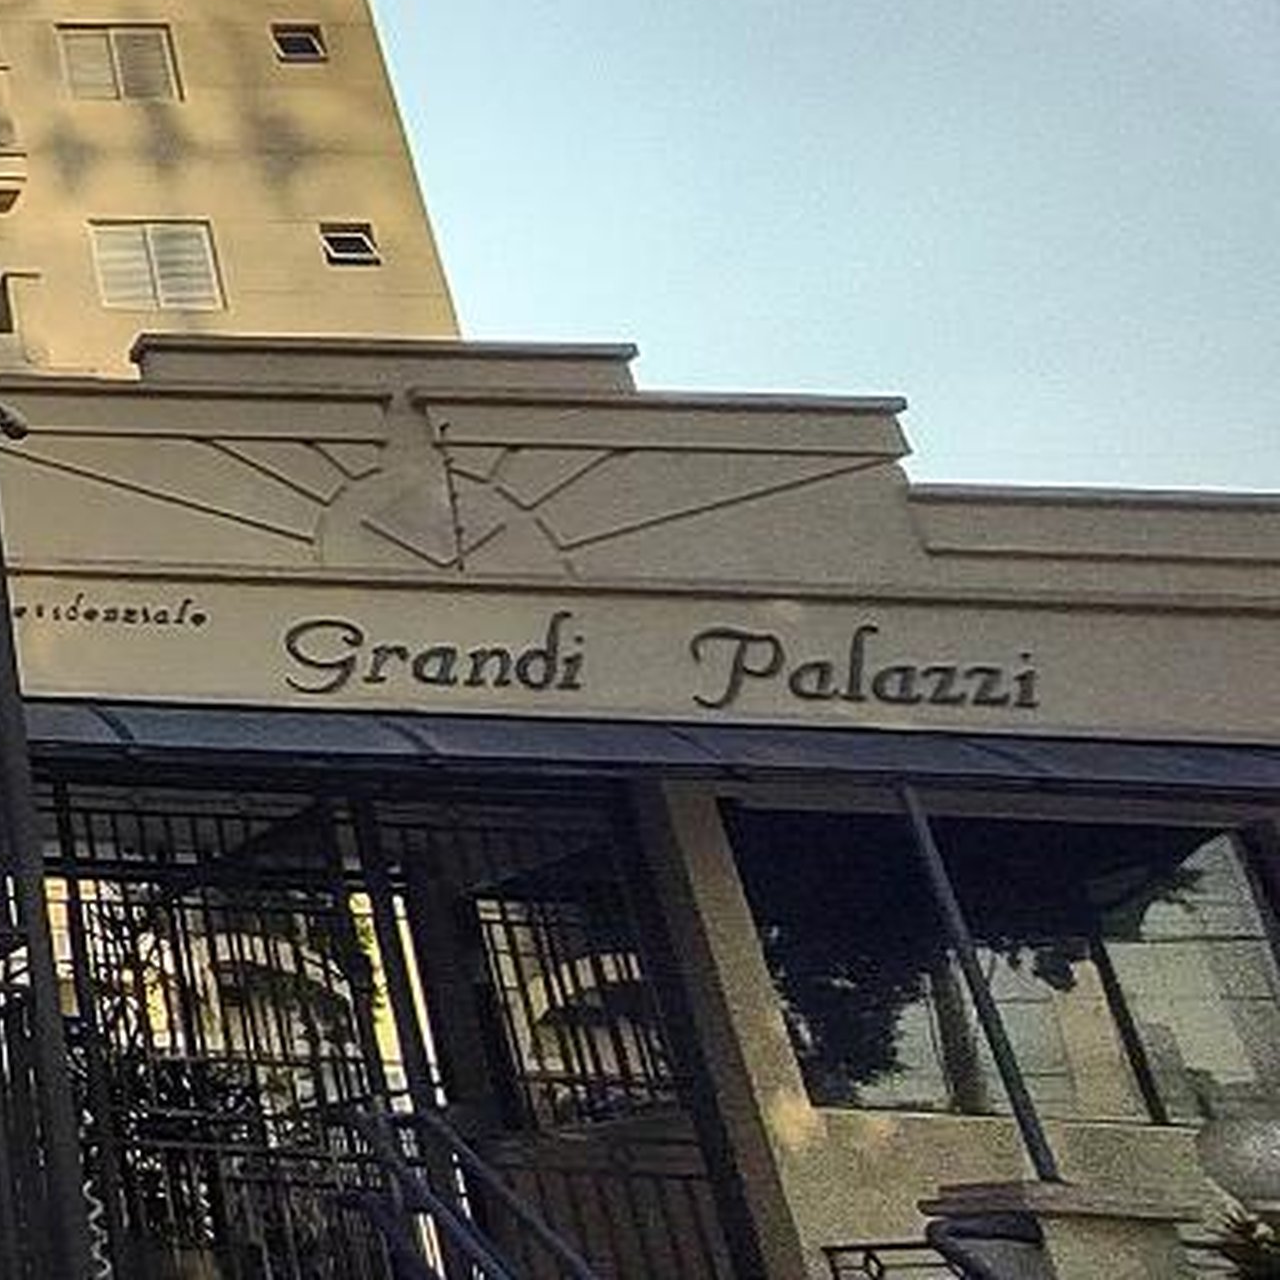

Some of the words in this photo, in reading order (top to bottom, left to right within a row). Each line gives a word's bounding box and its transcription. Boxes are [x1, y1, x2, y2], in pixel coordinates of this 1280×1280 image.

[13, 592, 208, 628] esidenziale
[284, 610, 586, 695] Grandi
[688, 624, 1041, 710] Palazzi
